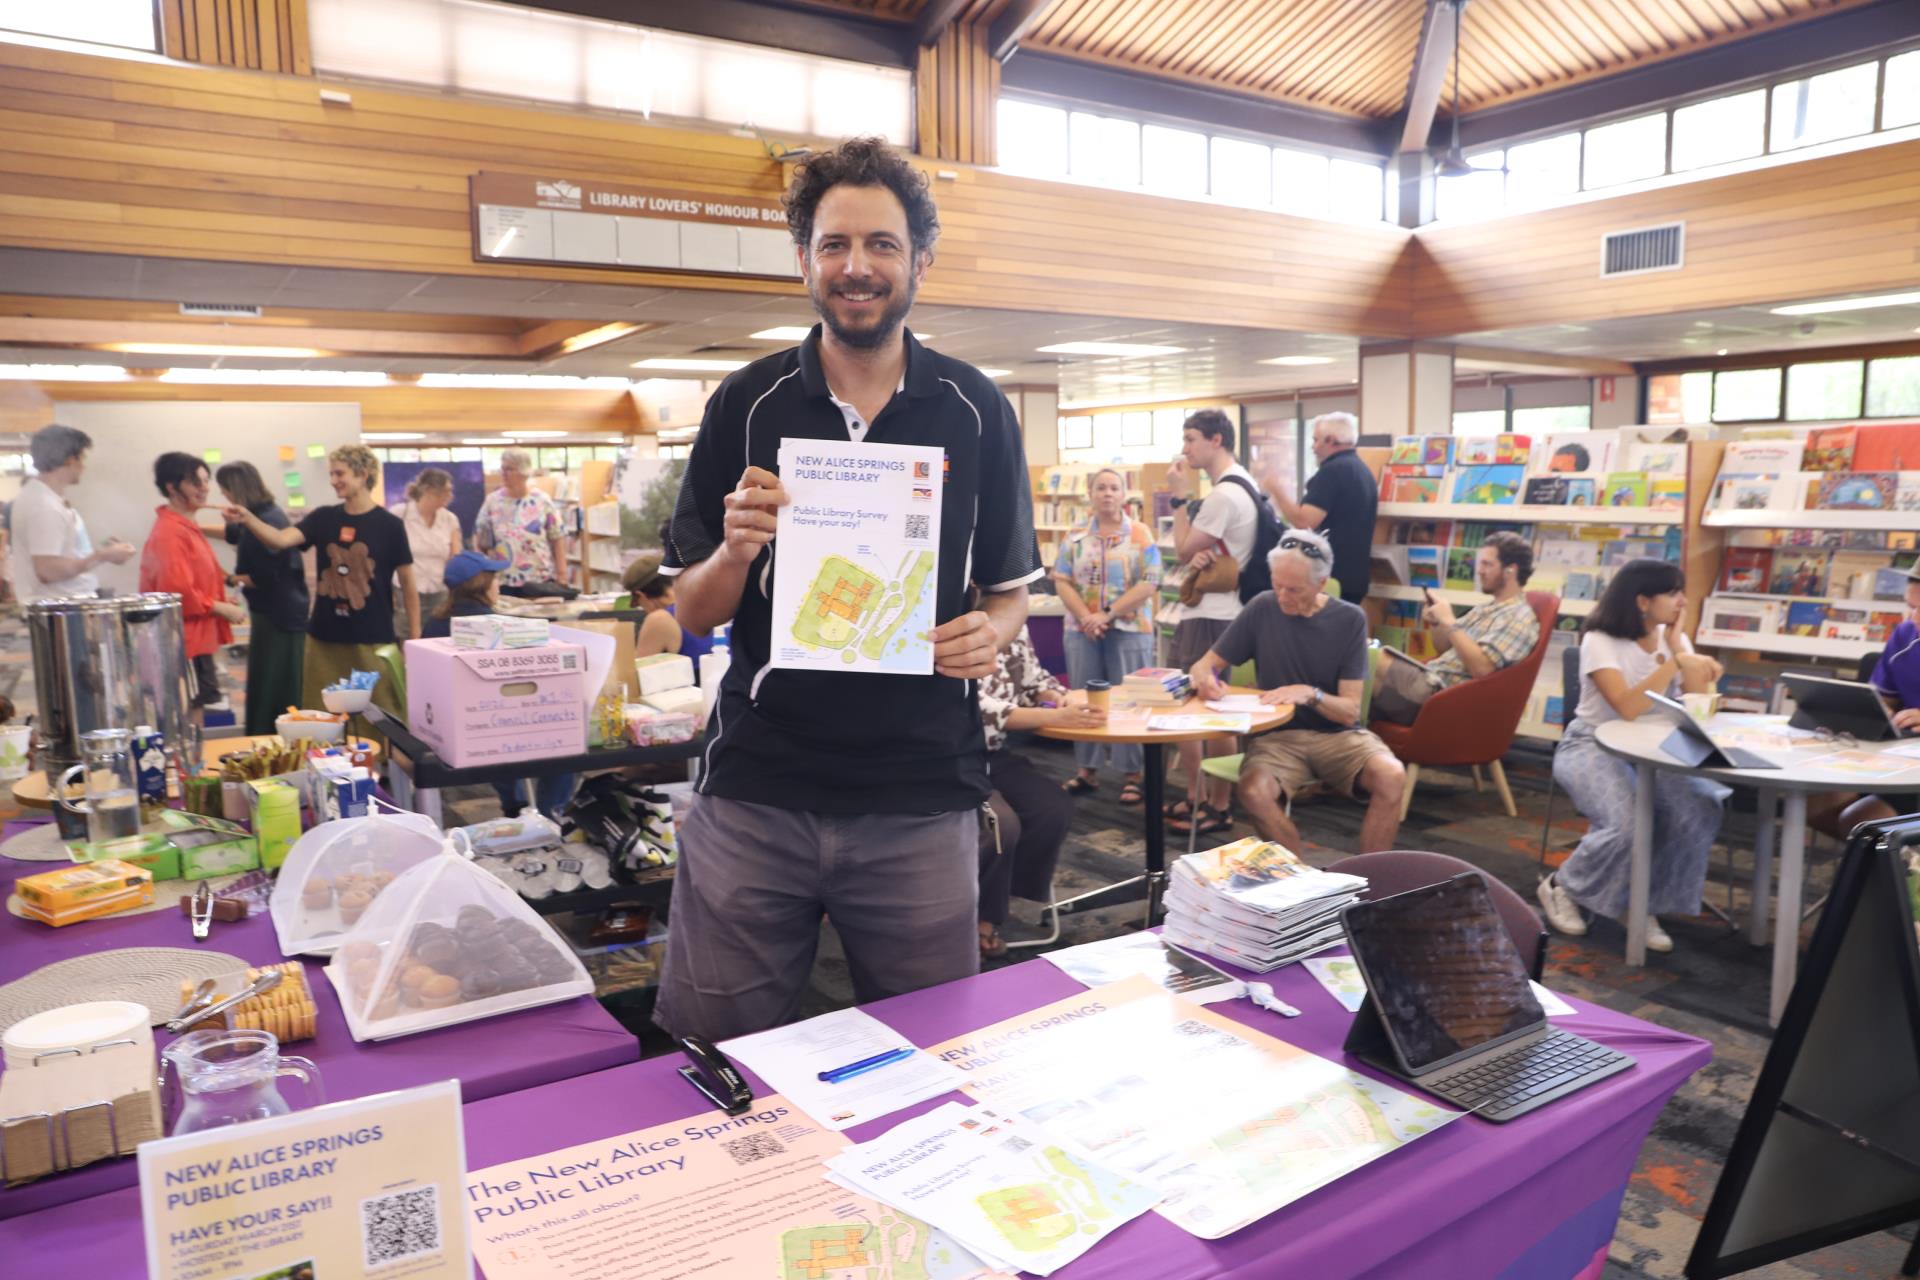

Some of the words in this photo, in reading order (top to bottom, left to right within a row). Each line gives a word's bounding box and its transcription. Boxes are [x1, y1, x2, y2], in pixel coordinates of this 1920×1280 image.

[590, 192, 647, 209] LIBRARY
[649, 198, 702, 214] LOVERS'
[705, 203, 758, 219] HONOUR
[761, 208, 787, 223] BOA
[795, 469, 833, 480] PUBLIC
[835, 471, 880, 482] LIBRARY
[796, 456, 823, 466] NEW
[825, 458, 855, 468] ALICE
[857, 459, 906, 471] SPRINGS
[793, 506, 821, 516] Public
[822, 507, 854, 519] Library
[857, 509, 888, 522] Survey
[793, 516, 817, 526] Have
[819, 519, 840, 528] your
[841, 519, 860, 530] say!
[478, 658, 497, 669] SSA
[982, 1027, 1029, 1049] ALICE
[1030, 1002, 1107, 1033] SPRINGS
[956, 1048, 1016, 1071] UBLIC
[165, 1159, 222, 1187] NEW
[228, 1146, 287, 1176] ALICE
[292, 1126, 384, 1159] SPRINGS
[467, 1181, 522, 1202] The
[528, 1158, 601, 1184] New
[611, 1135, 682, 1164] Alice
[685, 1105, 790, 1142] Springs
[861, 1162, 888, 1175] NEW
[889, 1148, 916, 1163] ALICE
[872, 1162, 911, 1181] PUBLIC
[907, 1142, 946, 1165] LIBRARY
[167, 1178, 247, 1210] PUBLIC
[251, 1158, 338, 1192] LIBRARY
[474, 1188, 575, 1223] Public
[578, 1155, 687, 1193] Library
[170, 1220, 224, 1246] HAVE
[227, 1208, 283, 1232] YOUR
[286, 1195, 332, 1218] SAY!!
[486, 1224, 540, 1244] What's
[542, 1217, 568, 1229] this
[571, 1209, 589, 1220] all
[591, 1194, 641, 1214] about?
